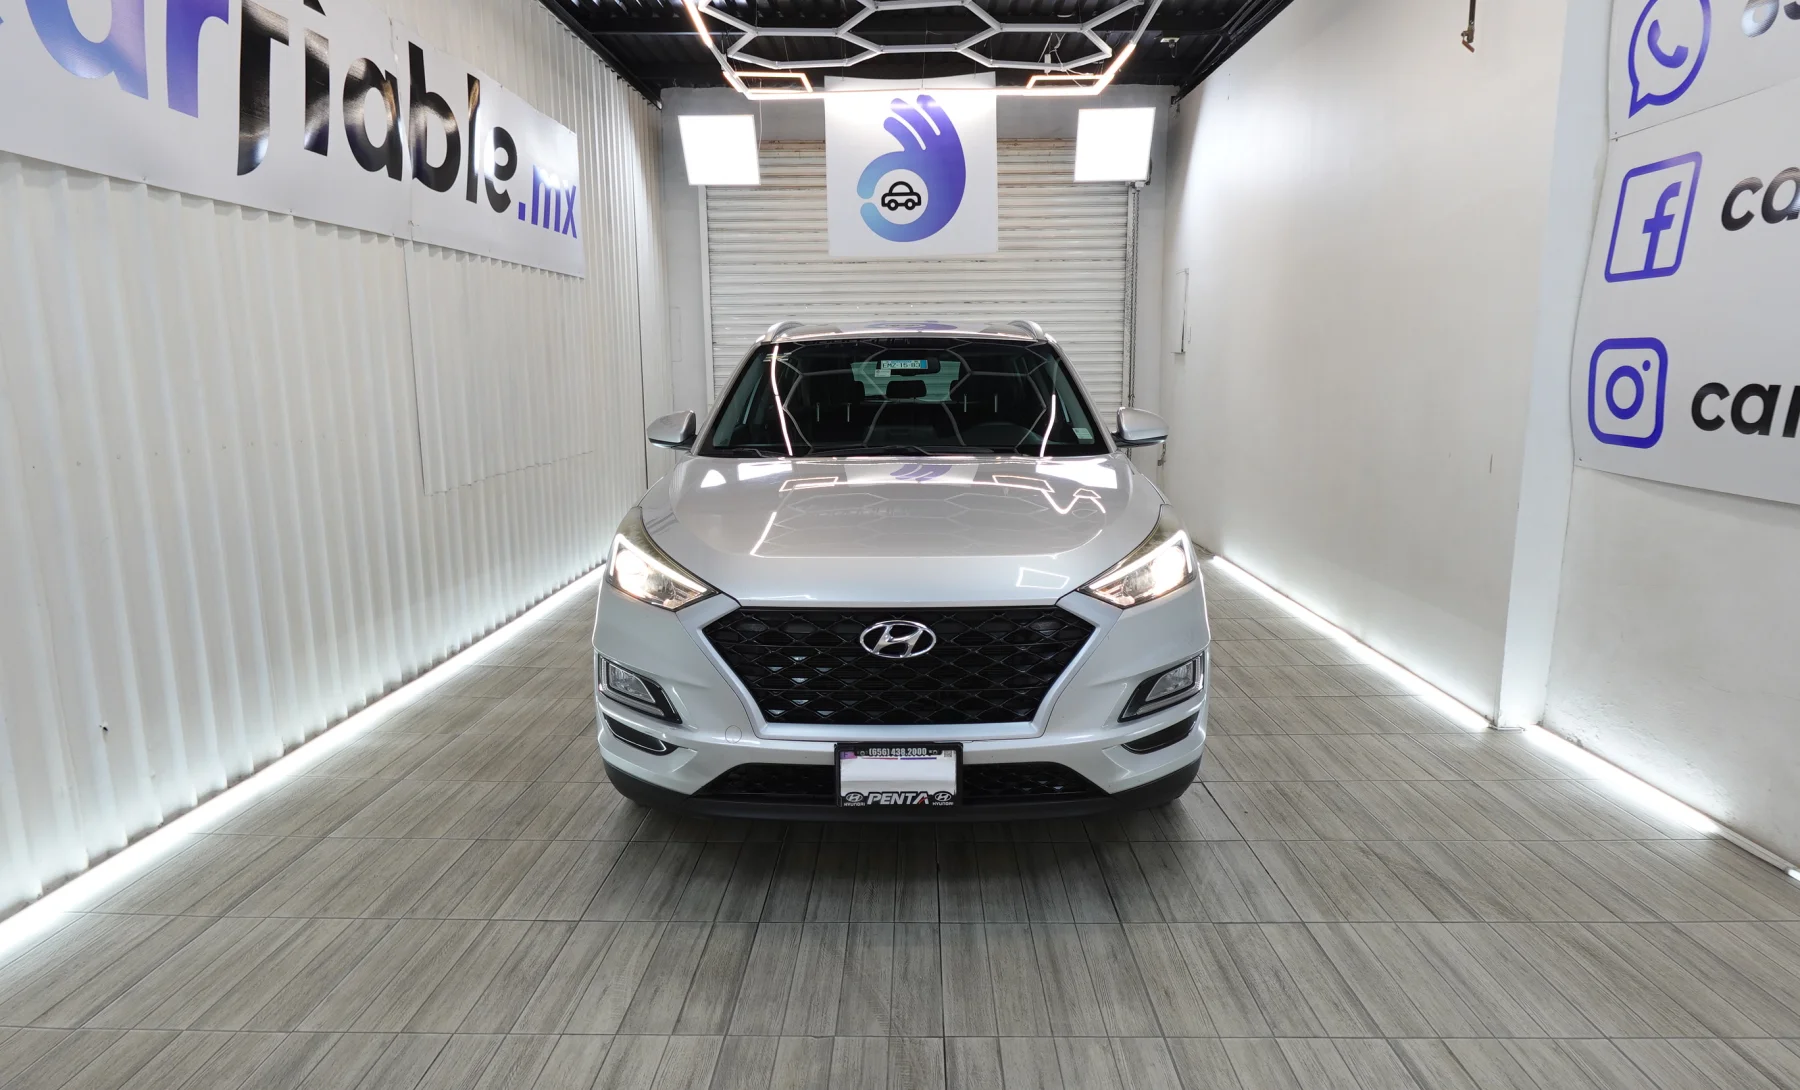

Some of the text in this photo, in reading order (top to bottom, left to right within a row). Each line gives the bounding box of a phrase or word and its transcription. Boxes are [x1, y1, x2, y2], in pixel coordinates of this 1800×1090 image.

[868, 748, 927, 756] (656) 438.2000
[867, 793, 929, 805] PENTA
